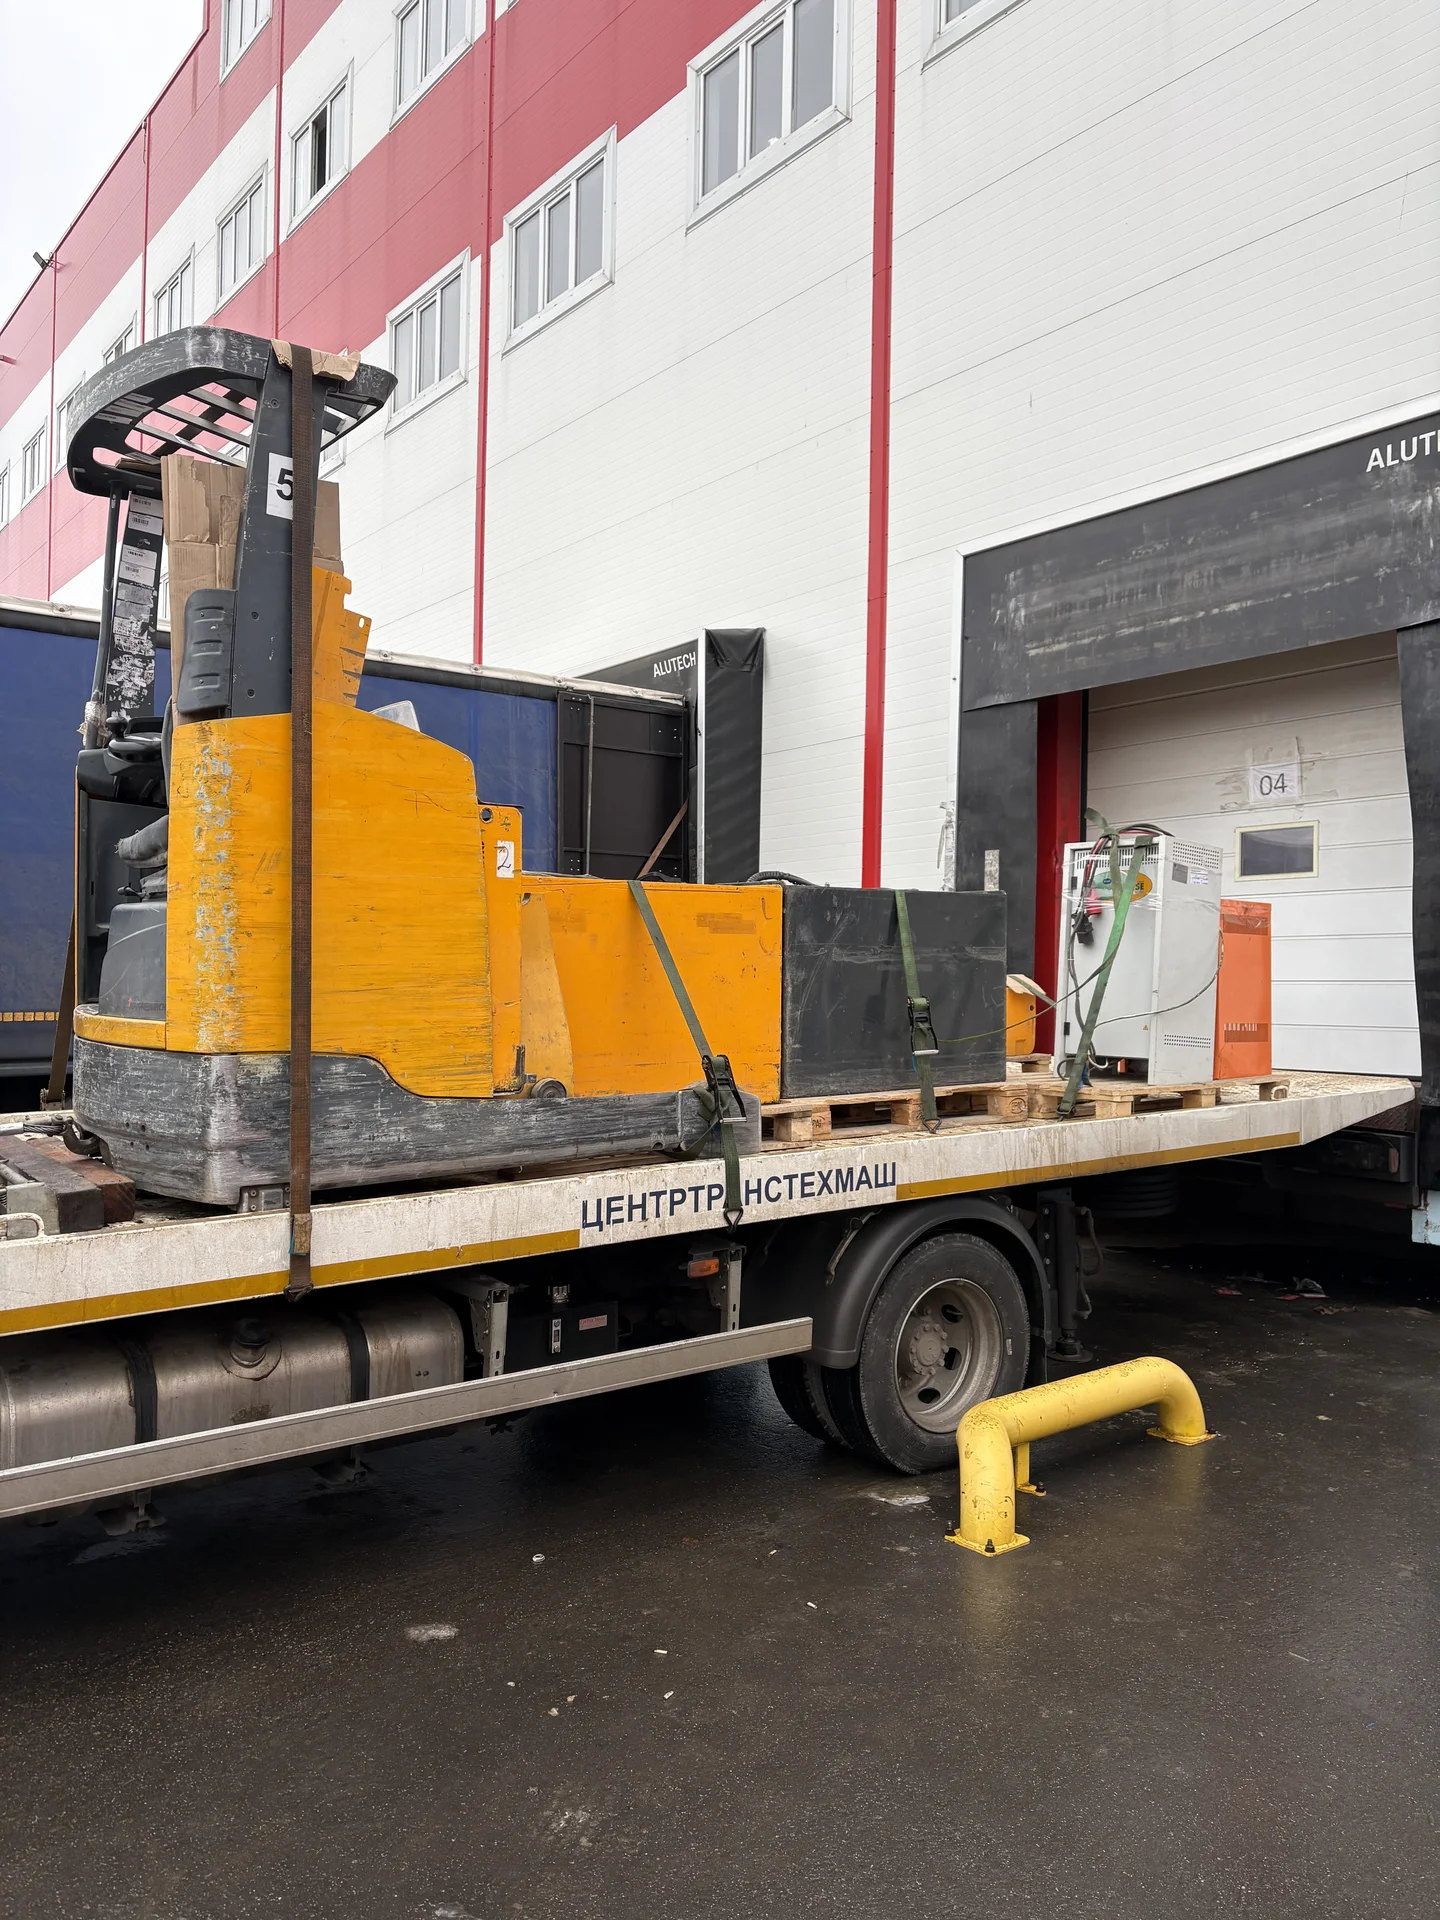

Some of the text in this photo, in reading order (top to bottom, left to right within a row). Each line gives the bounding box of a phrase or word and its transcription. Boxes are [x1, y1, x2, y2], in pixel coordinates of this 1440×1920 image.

[1365, 429, 1440, 473] ALUT
[276, 467, 293, 501] 5
[653, 651, 696, 678] ALUTECH
[1259, 772, 1288, 796] 04
[496, 845, 512, 871] 2
[581, 1161, 897, 1232] ЦЕНТРТРНСТЕХМАШ
